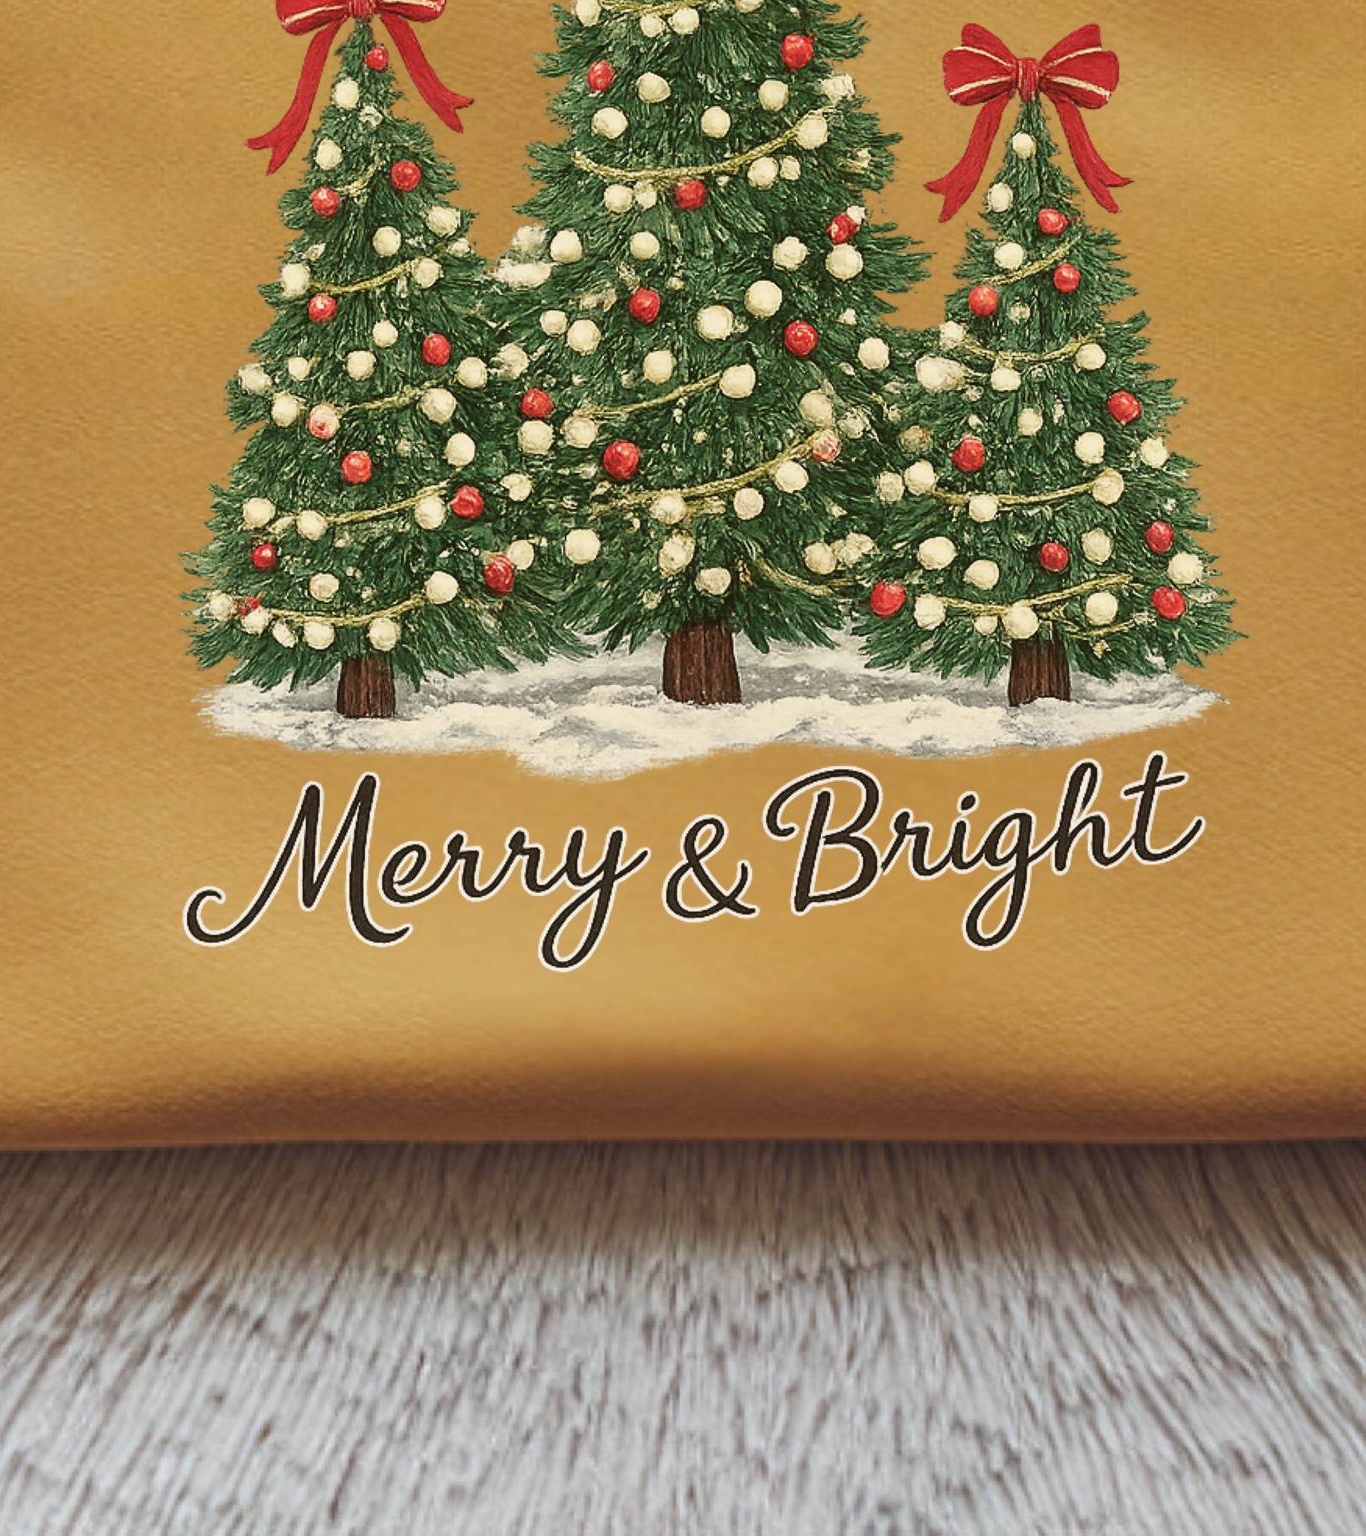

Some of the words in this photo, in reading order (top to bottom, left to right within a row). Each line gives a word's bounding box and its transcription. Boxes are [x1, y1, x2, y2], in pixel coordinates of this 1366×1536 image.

[184, 772, 649, 971] Merry
[664, 814, 759, 921] &
[764, 752, 1205, 950] Bright
